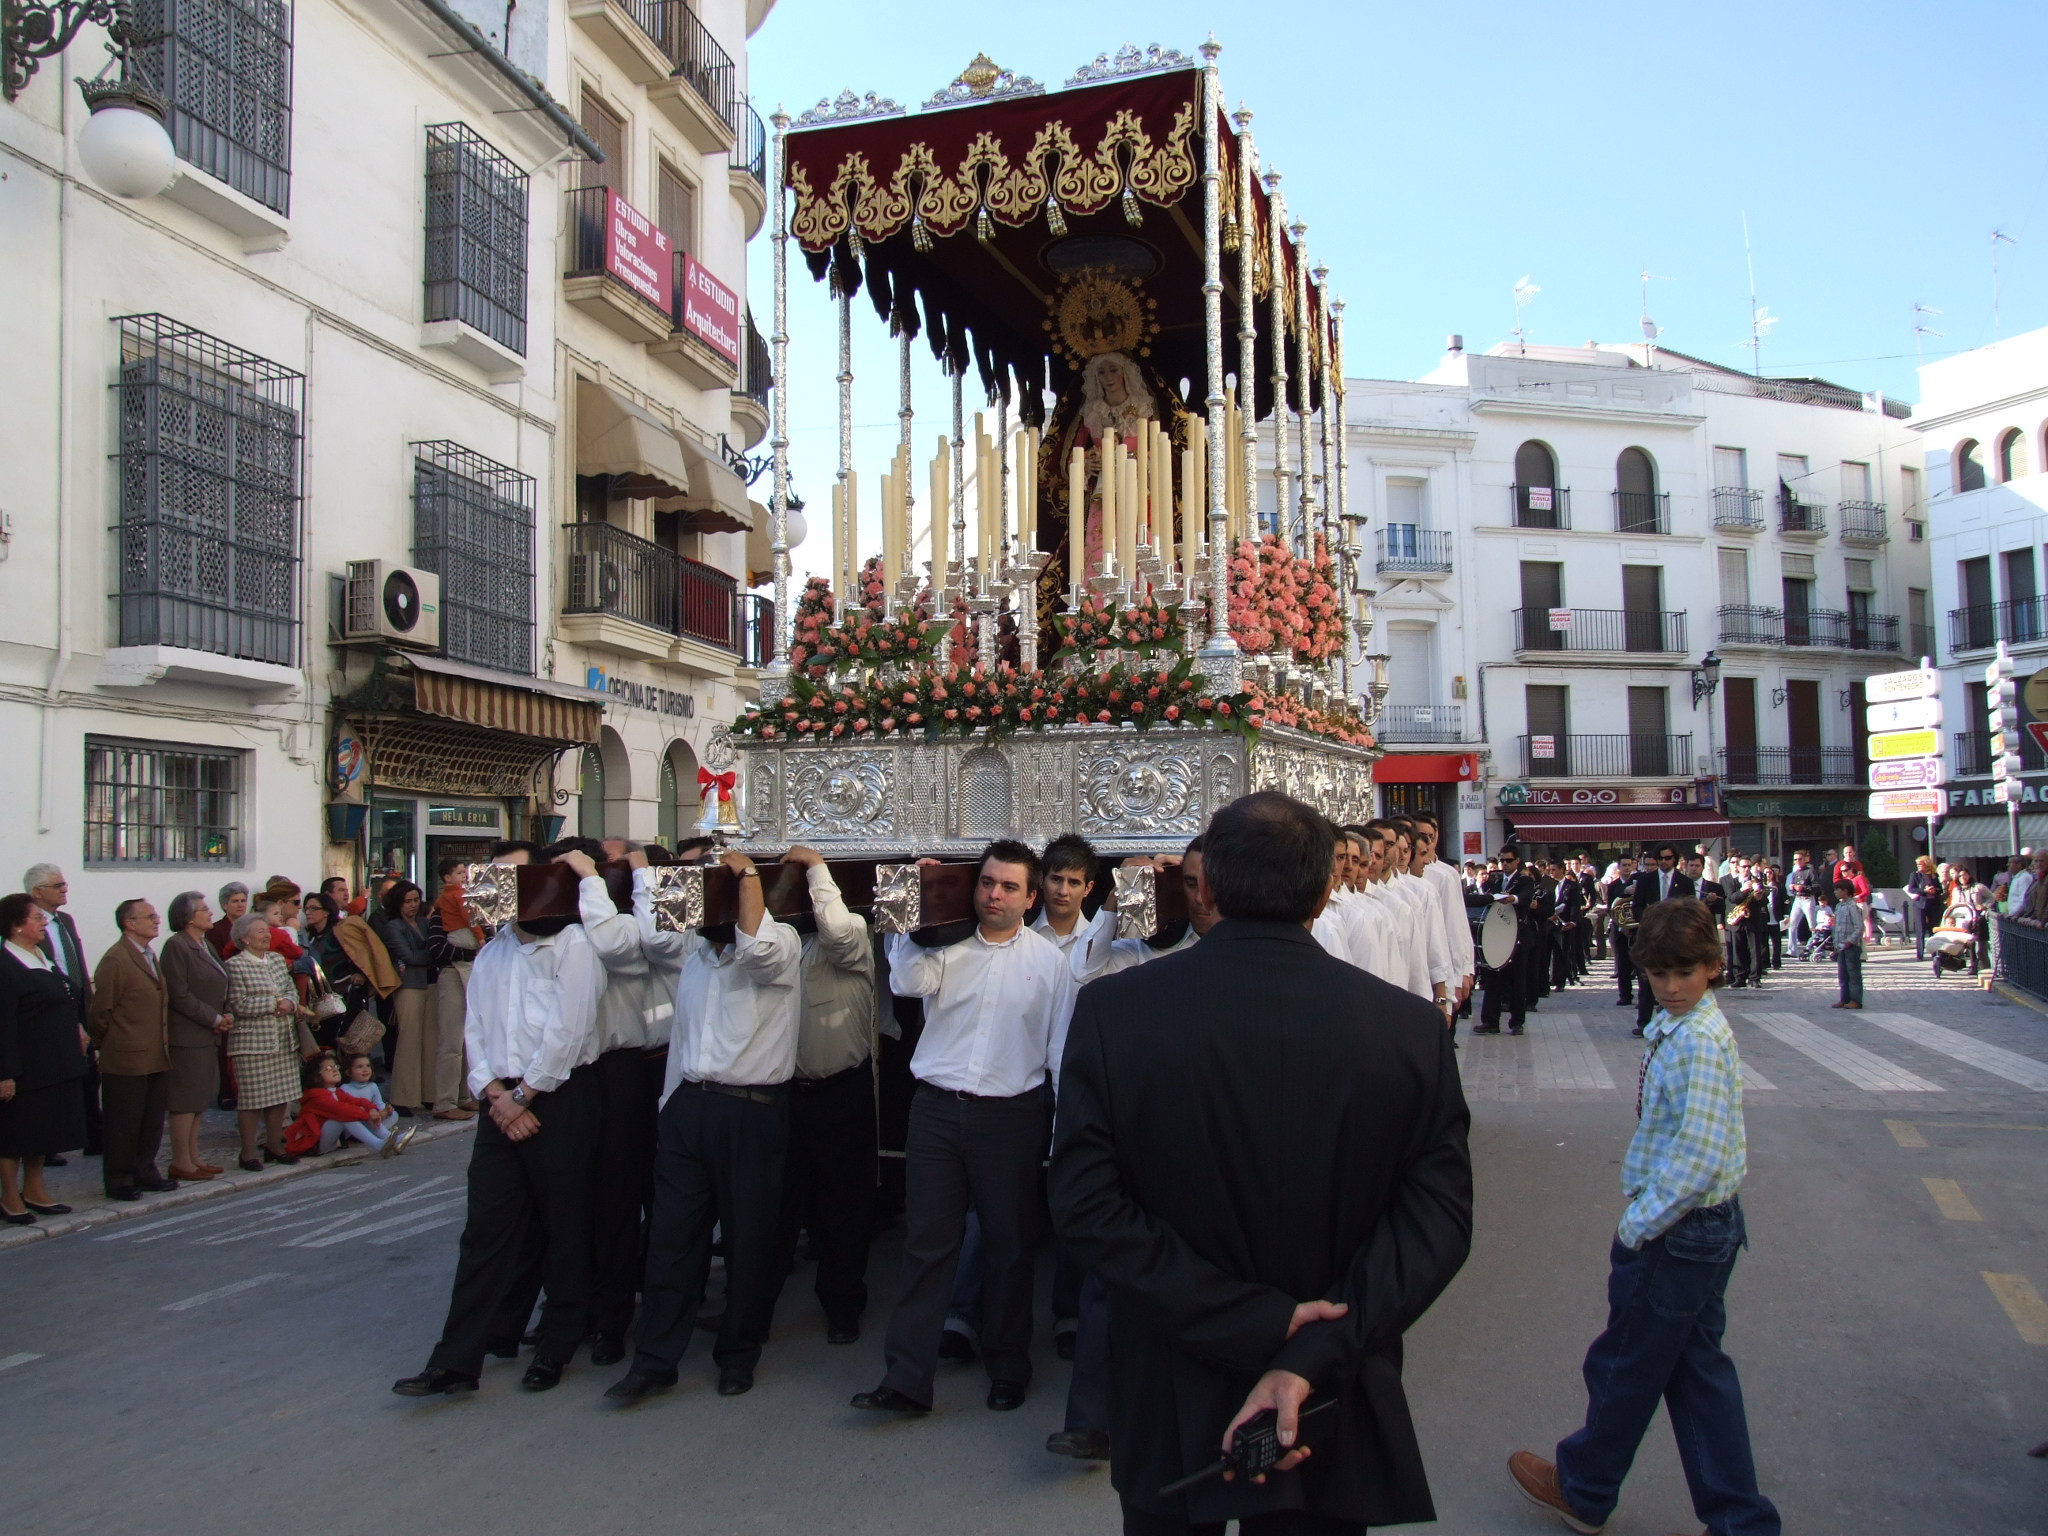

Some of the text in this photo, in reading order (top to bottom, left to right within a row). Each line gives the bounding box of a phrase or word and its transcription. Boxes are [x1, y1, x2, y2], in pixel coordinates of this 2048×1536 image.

[615, 197, 666, 252] ESTUDIO DE
[615, 218, 637, 248] Obras
[614, 255, 660, 303] Presupuestos
[615, 237, 658, 282] Valoraciones
[698, 271, 735, 316] ESTUDIO
[686, 299, 737, 355] Arquitectura
[646, 685, 658, 712] DE
[658, 688, 695, 719] TURISMO
[1949, 786, 2048, 806] FARAC
